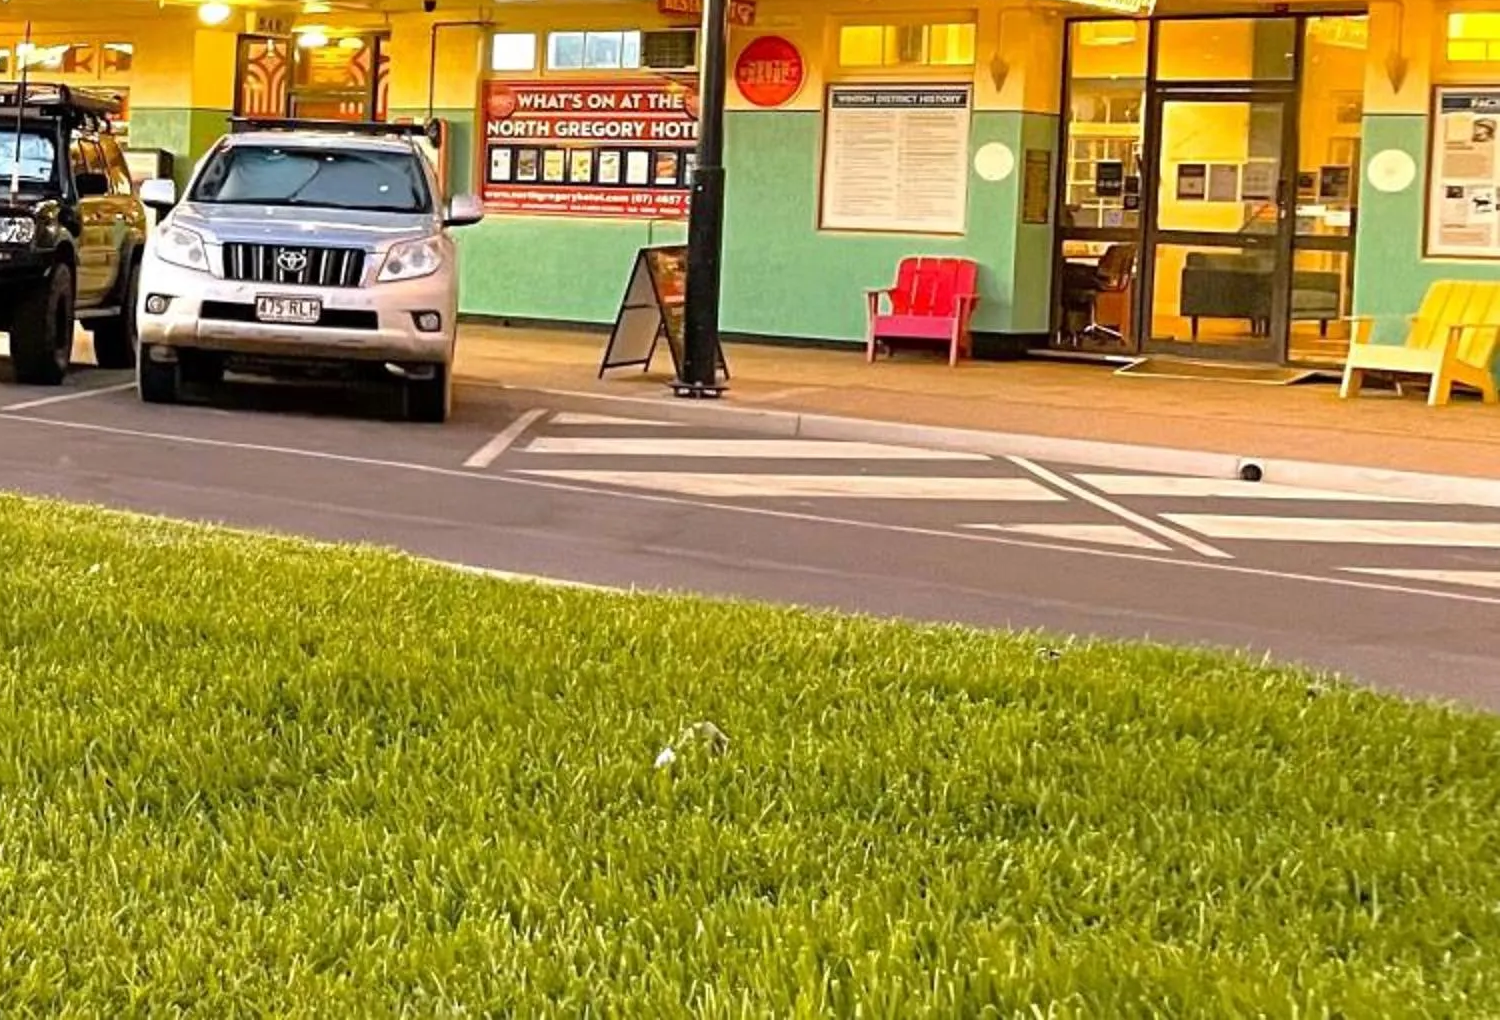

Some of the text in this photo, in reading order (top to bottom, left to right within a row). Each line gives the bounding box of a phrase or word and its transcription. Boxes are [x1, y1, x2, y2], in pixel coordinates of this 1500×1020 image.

[517, 93, 583, 109] WHAT'S
[587, 94, 615, 109] ON
[619, 94, 642, 109] AT
[647, 93, 684, 110] THE
[487, 121, 699, 138] NORTH GREGORY HOT
